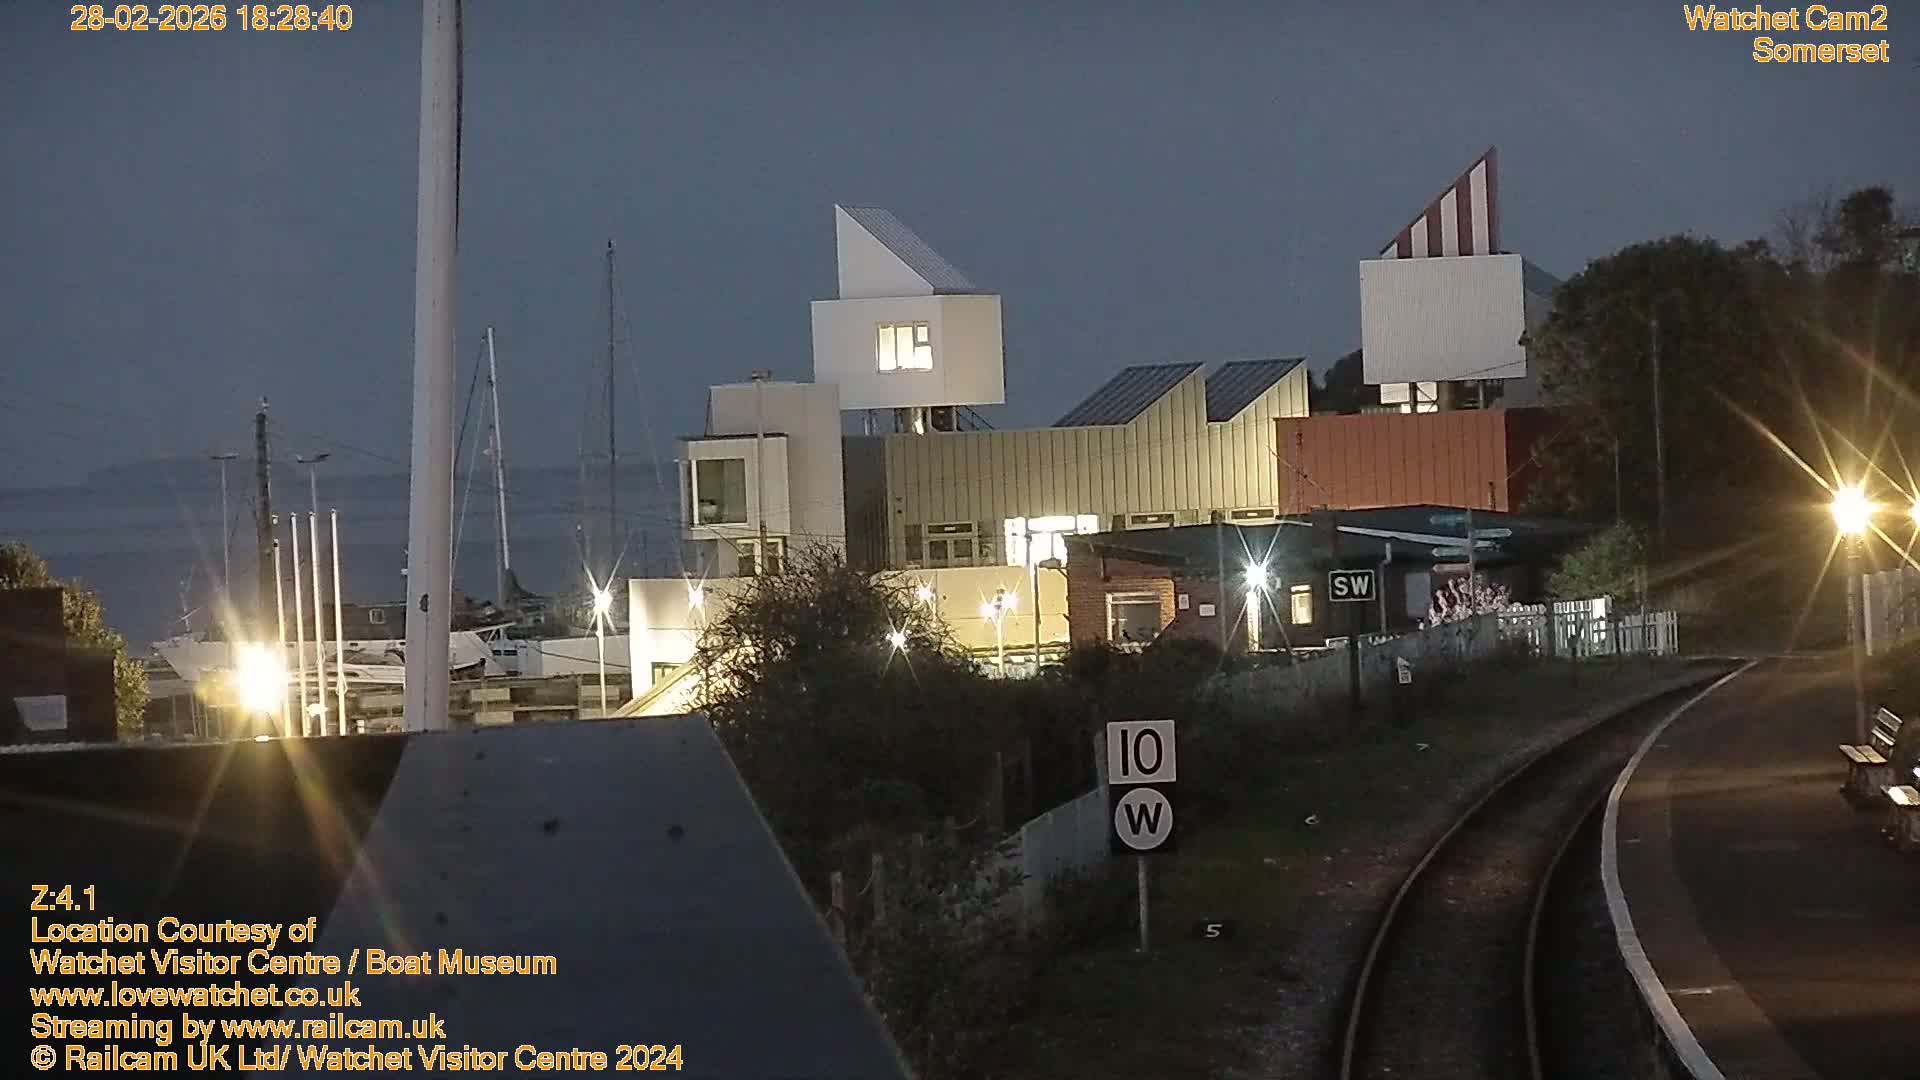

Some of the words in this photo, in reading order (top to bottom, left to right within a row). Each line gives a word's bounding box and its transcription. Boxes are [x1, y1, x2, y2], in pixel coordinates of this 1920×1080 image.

[1334, 576, 1369, 596] SW
[1120, 727, 1163, 777] 10
[1124, 802, 1163, 836] W
[1204, 923, 1222, 938] 5
